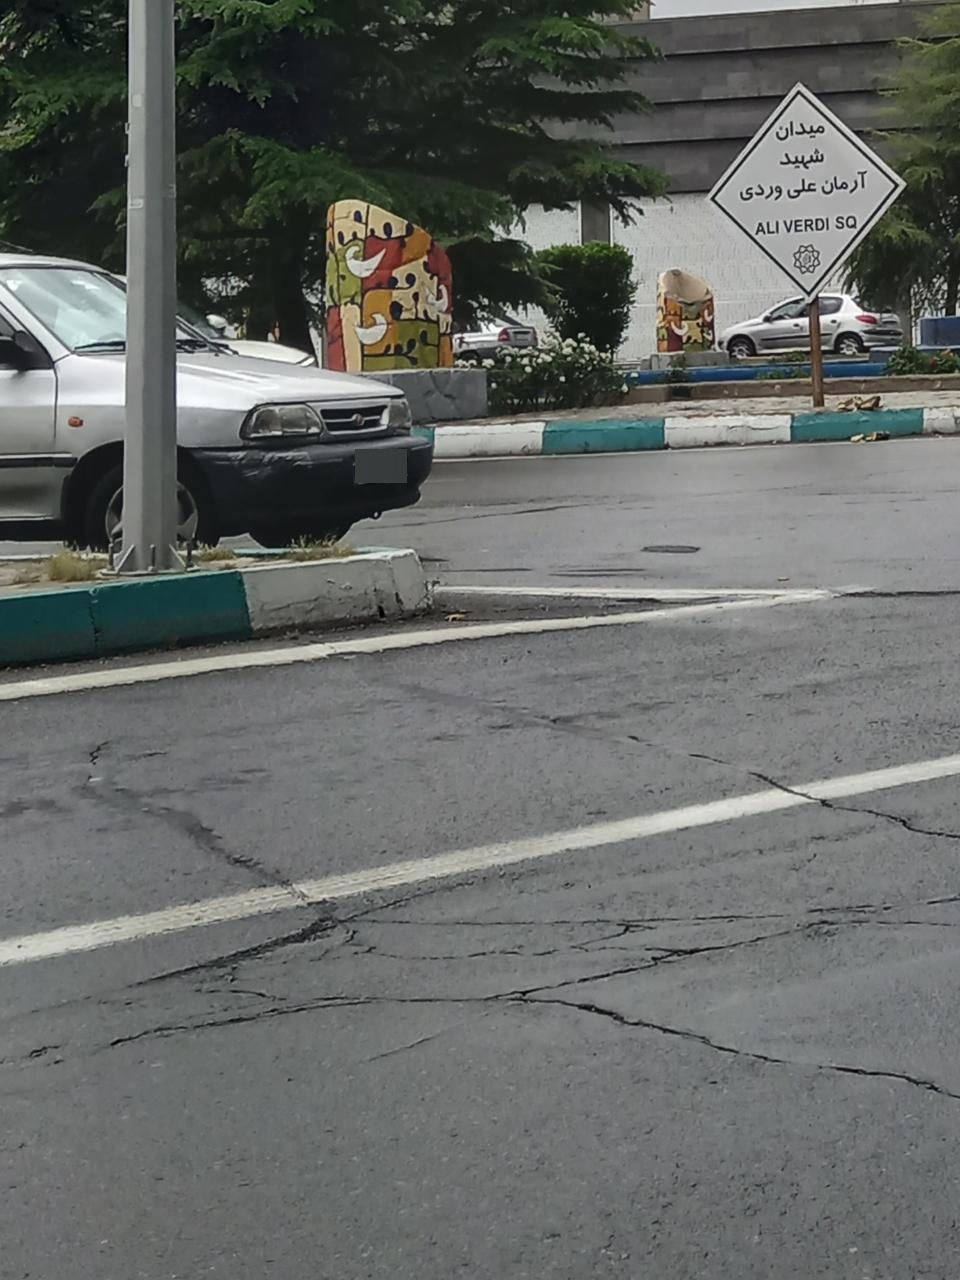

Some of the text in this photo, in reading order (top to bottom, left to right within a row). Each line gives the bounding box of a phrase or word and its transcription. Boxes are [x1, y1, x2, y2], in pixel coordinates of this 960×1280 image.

[775, 121, 825, 141] میدان
[779, 148, 825, 169] شهید
[820, 171, 868, 195] آرمان
[755, 215, 858, 236] ALI VERDI SQ
